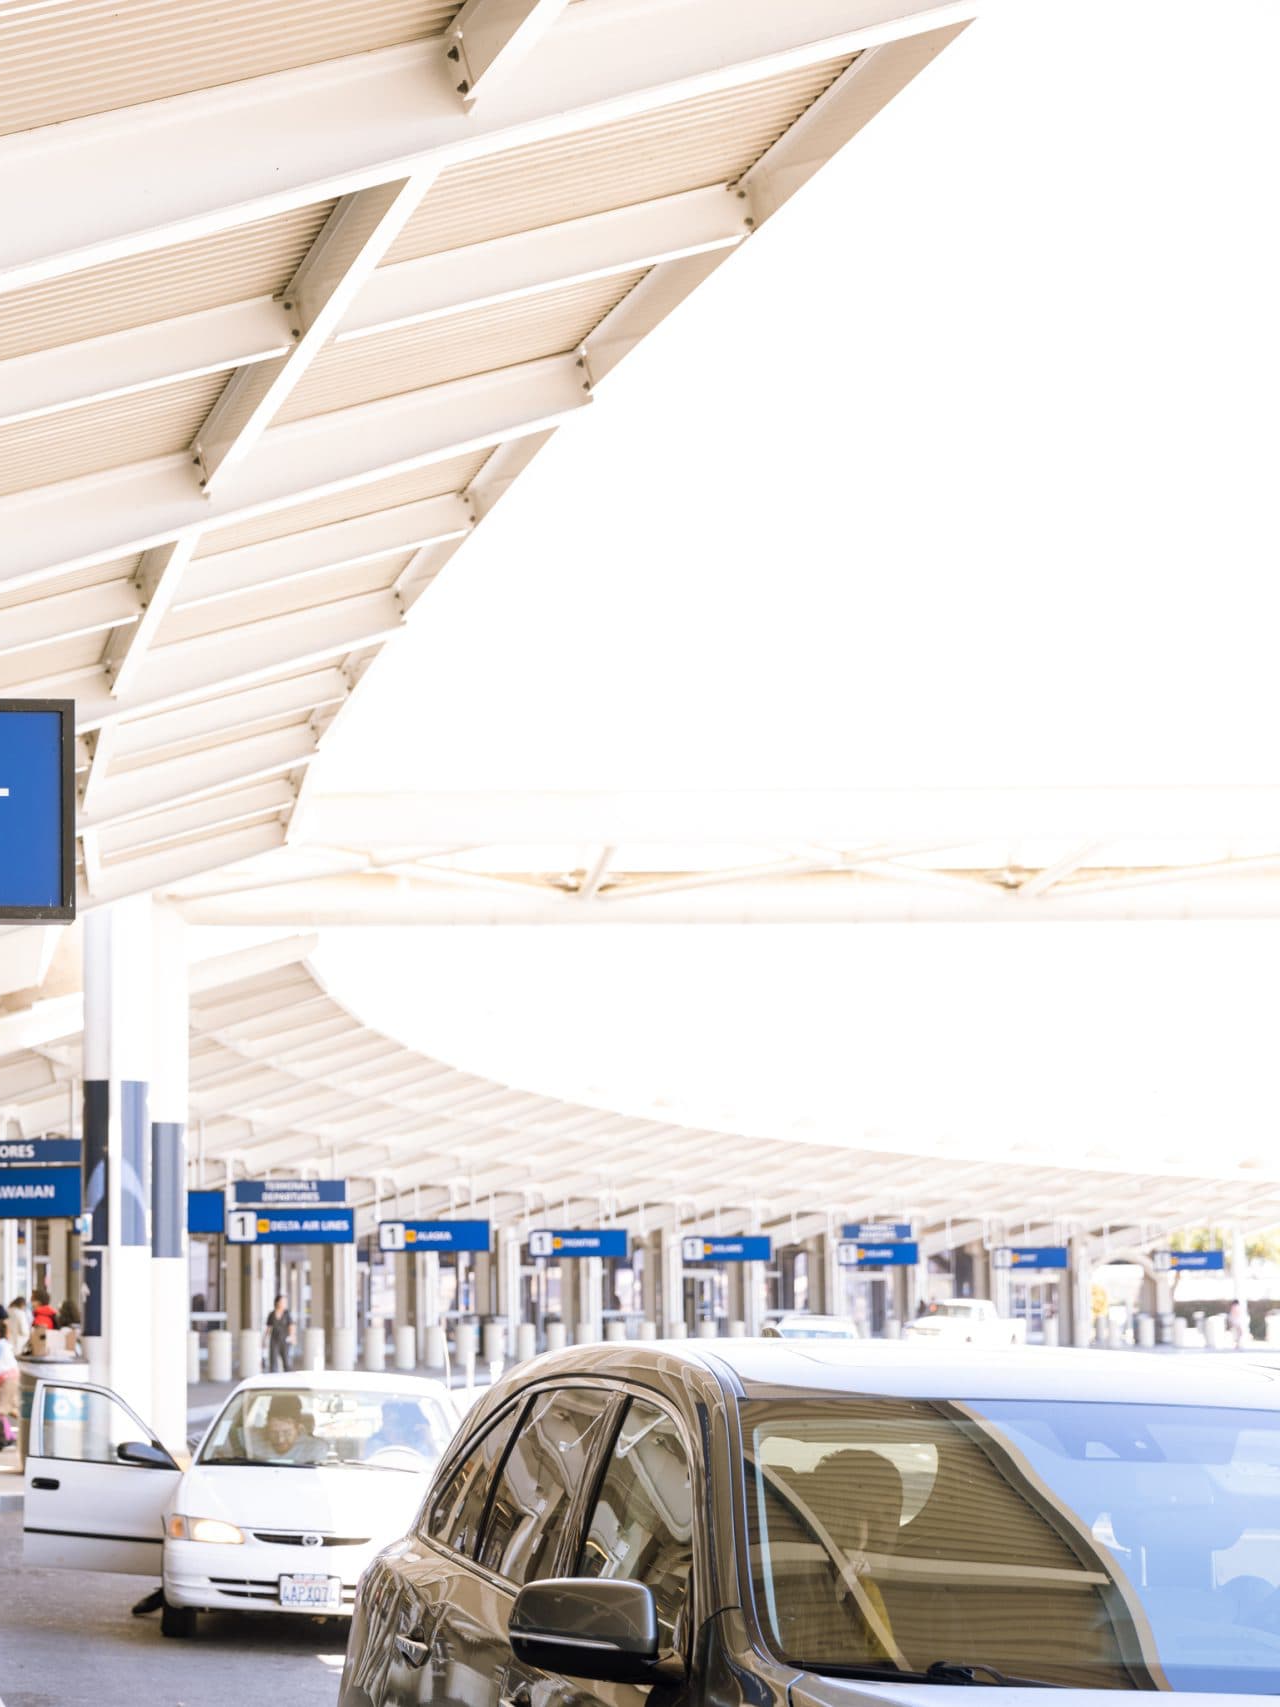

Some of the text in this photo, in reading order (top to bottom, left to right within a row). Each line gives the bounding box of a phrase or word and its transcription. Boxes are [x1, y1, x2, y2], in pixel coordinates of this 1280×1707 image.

[237, 1216, 246, 1237] 1
[270, 1220, 350, 1231] DELTA AIR LINES
[388, 1227, 396, 1245] 1
